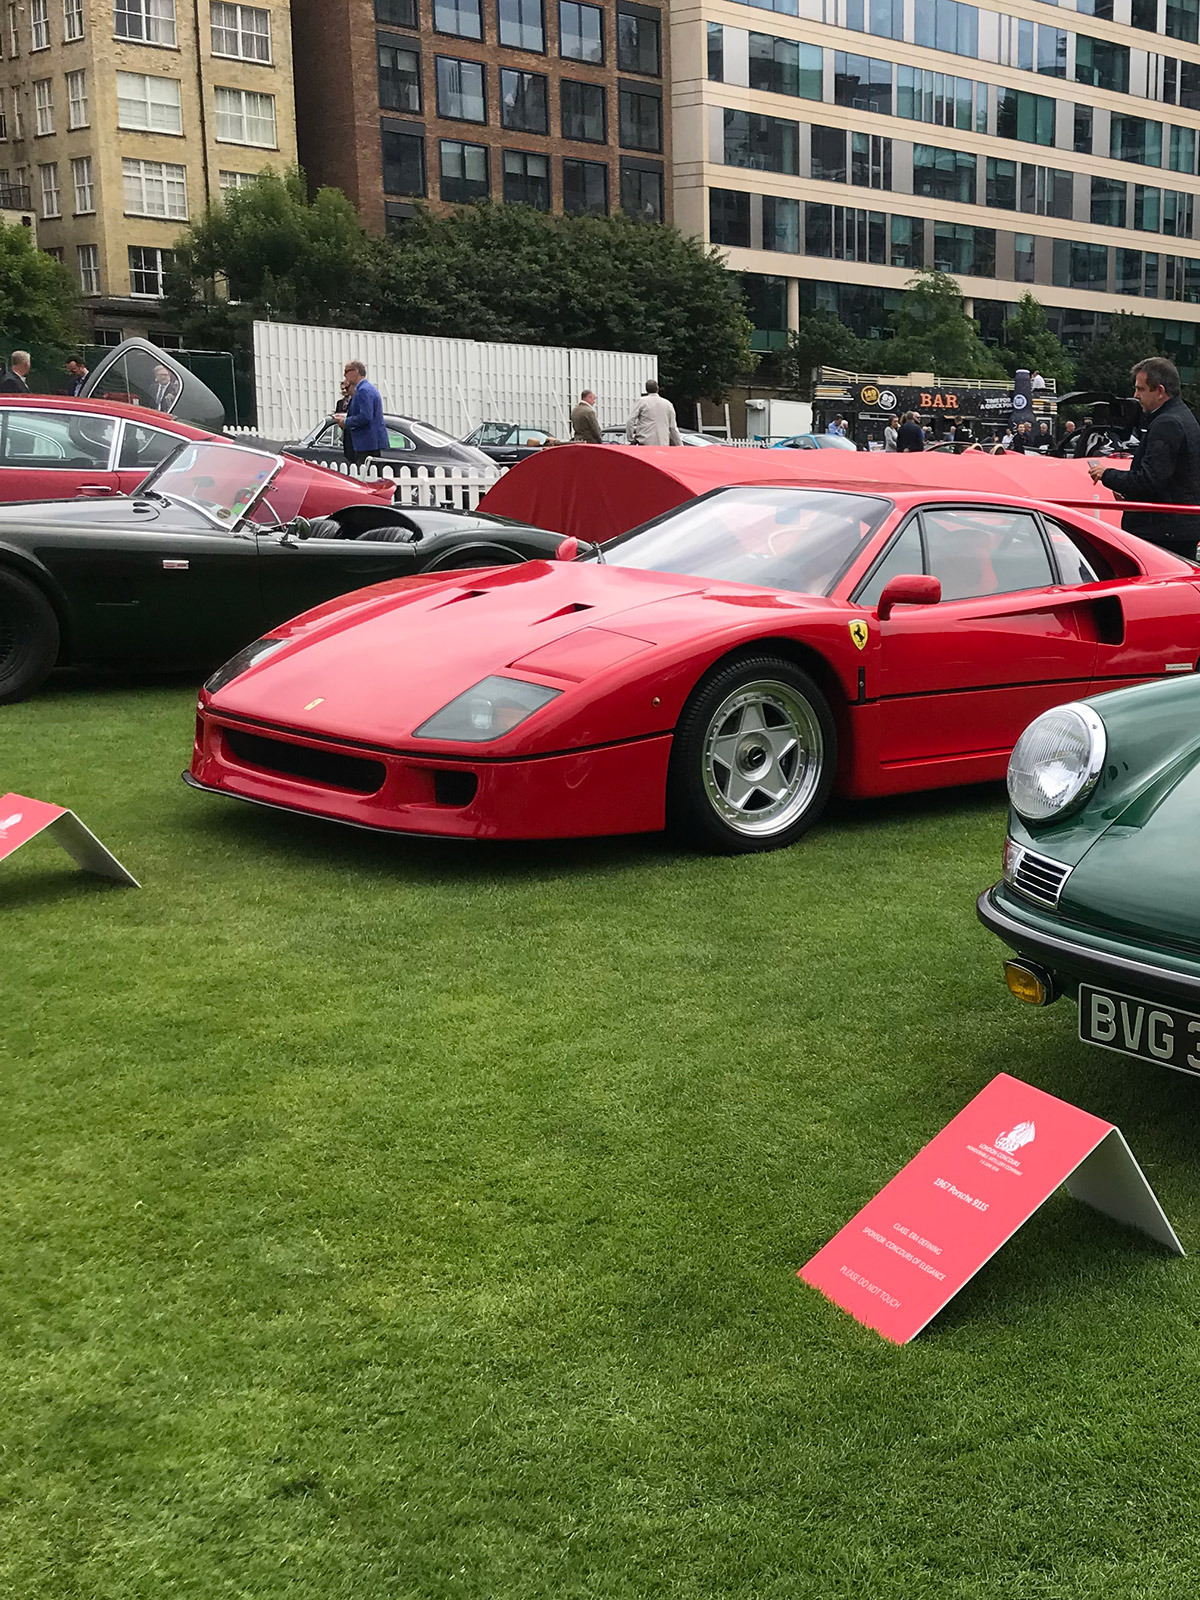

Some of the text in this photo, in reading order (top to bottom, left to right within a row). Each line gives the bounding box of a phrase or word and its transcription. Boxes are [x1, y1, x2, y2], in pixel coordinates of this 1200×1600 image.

[920, 393, 958, 409] BAR
[1091, 993, 1174, 1059] BVG
[979, 1143, 1021, 1167] LONDON CONCOURS
[933, 1177, 952, 1190] 1967
[948, 1185, 973, 1203] Porsche
[908, 1231, 920, 1242] ERA
[917, 1237, 943, 1255] DEFINING
[885, 1241, 914, 1261] CONCOURS
[911, 1257, 921, 1265] OF
[918, 1261, 947, 1281] ELEGANCE
[840, 1265, 902, 1310] PLEASE DO NOT TOUCH
